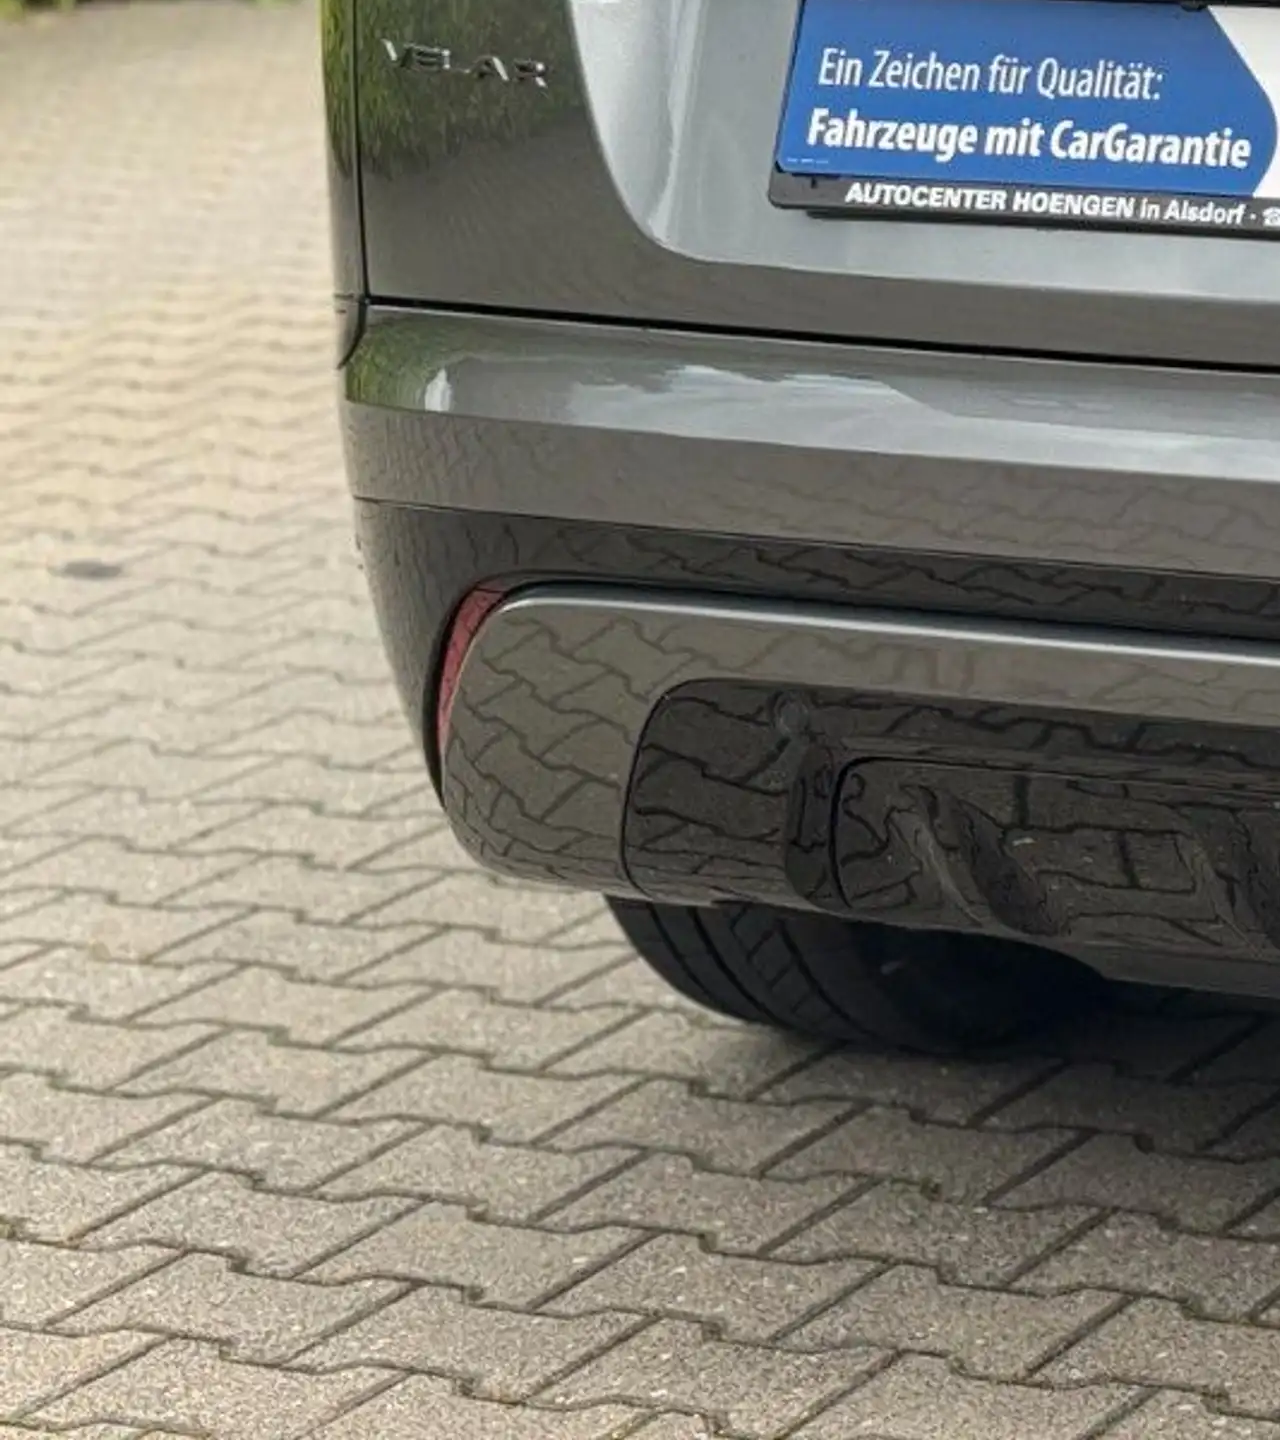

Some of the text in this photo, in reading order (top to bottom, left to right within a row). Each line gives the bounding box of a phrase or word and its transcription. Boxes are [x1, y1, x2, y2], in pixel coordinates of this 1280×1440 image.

[818, 46, 1163, 100] Ein Zeichen für Qualität:
[806, 106, 1252, 168] Fahrzeuge mit CarGarantie
[844, 182, 1008, 212] AUTOCENTER
[1012, 191, 1136, 219] HOENGEN
[1140, 198, 1160, 220] in
[1163, 200, 1246, 225] Alsdorf
